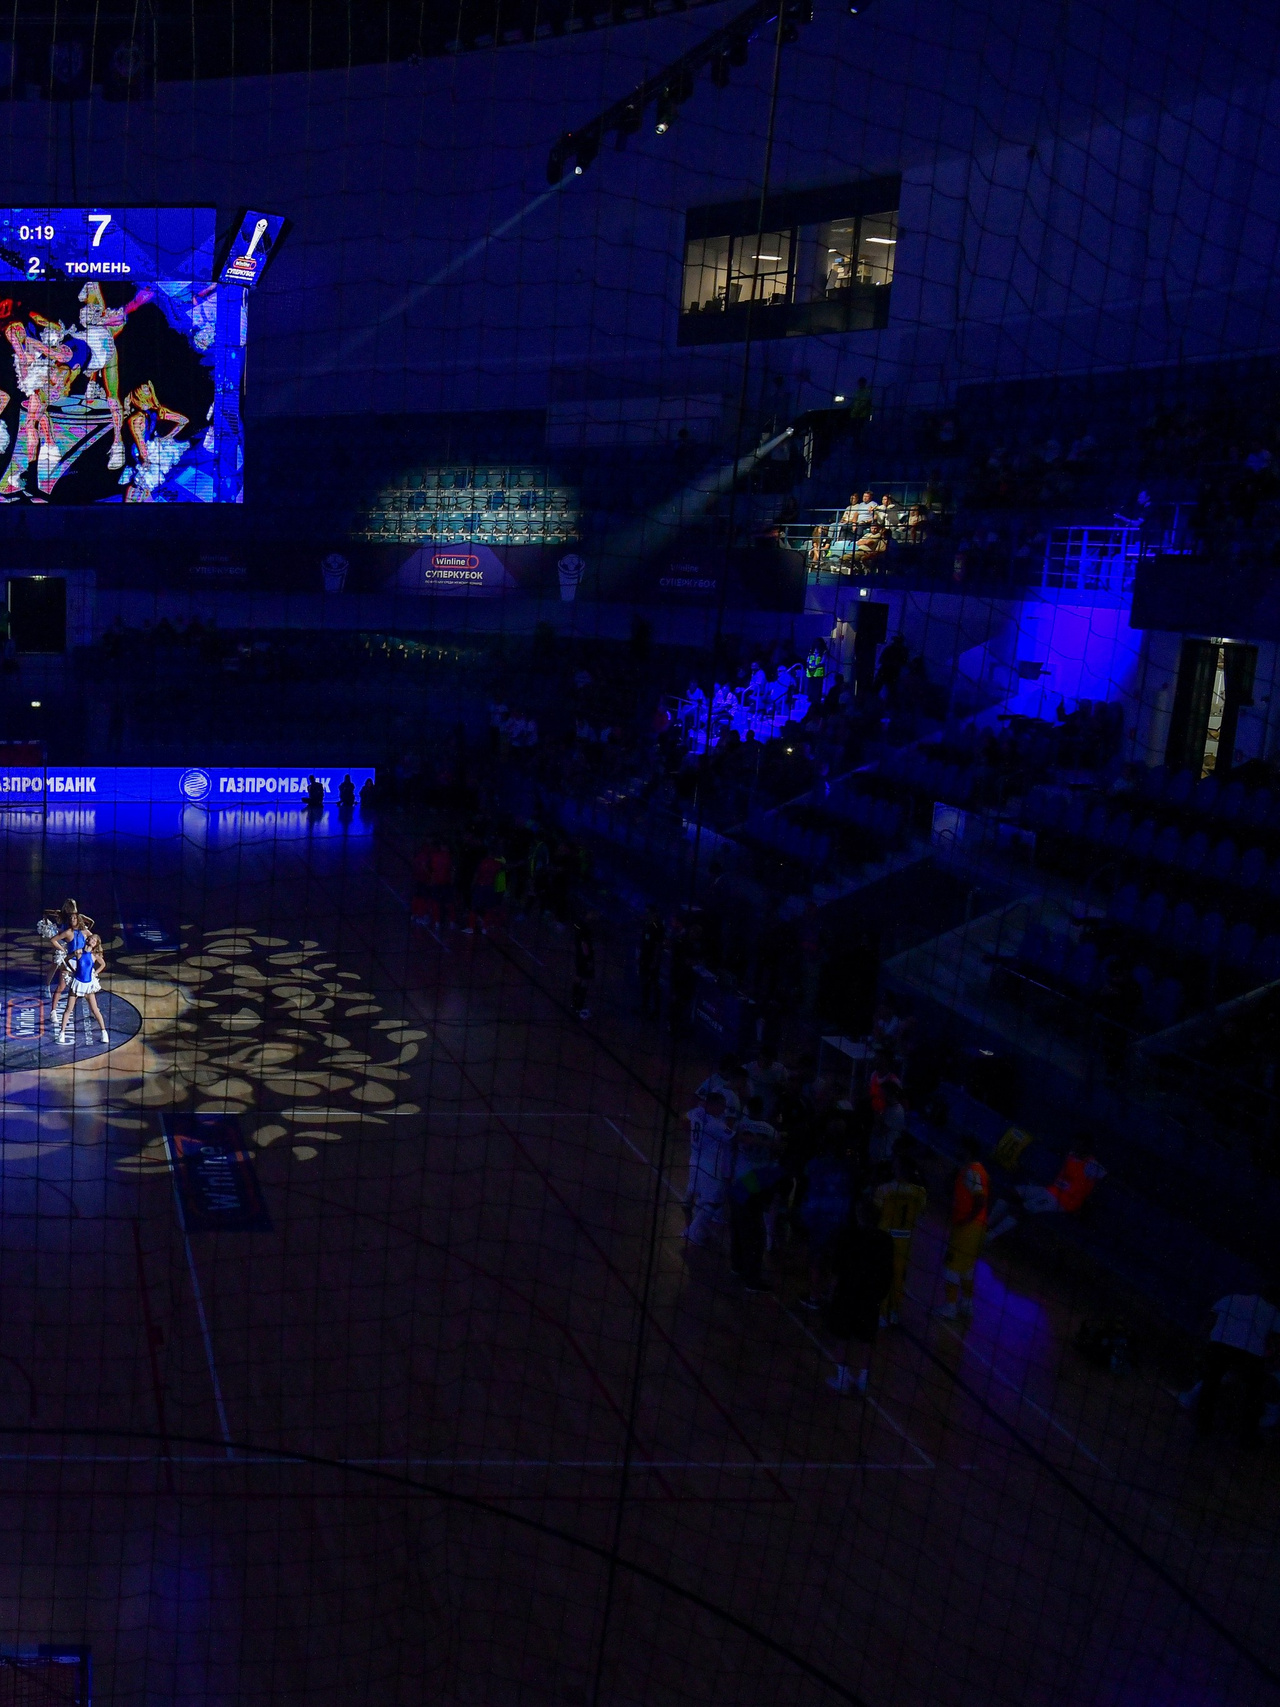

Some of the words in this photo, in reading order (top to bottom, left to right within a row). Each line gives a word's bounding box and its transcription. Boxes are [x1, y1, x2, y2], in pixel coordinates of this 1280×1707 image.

[20, 226, 54, 240] 0:19
[88, 215, 112, 247] 7
[28, 257, 46, 273] 2.
[65, 262, 131, 273] ТЮМЕНЬ
[436, 558, 466, 566] Winline
[425, 570, 483, 580] СУПЕРКУБОК
[219, 777, 331, 793] ГАЗПРОМБАК
[16, 1008, 35, 1035] Winline
